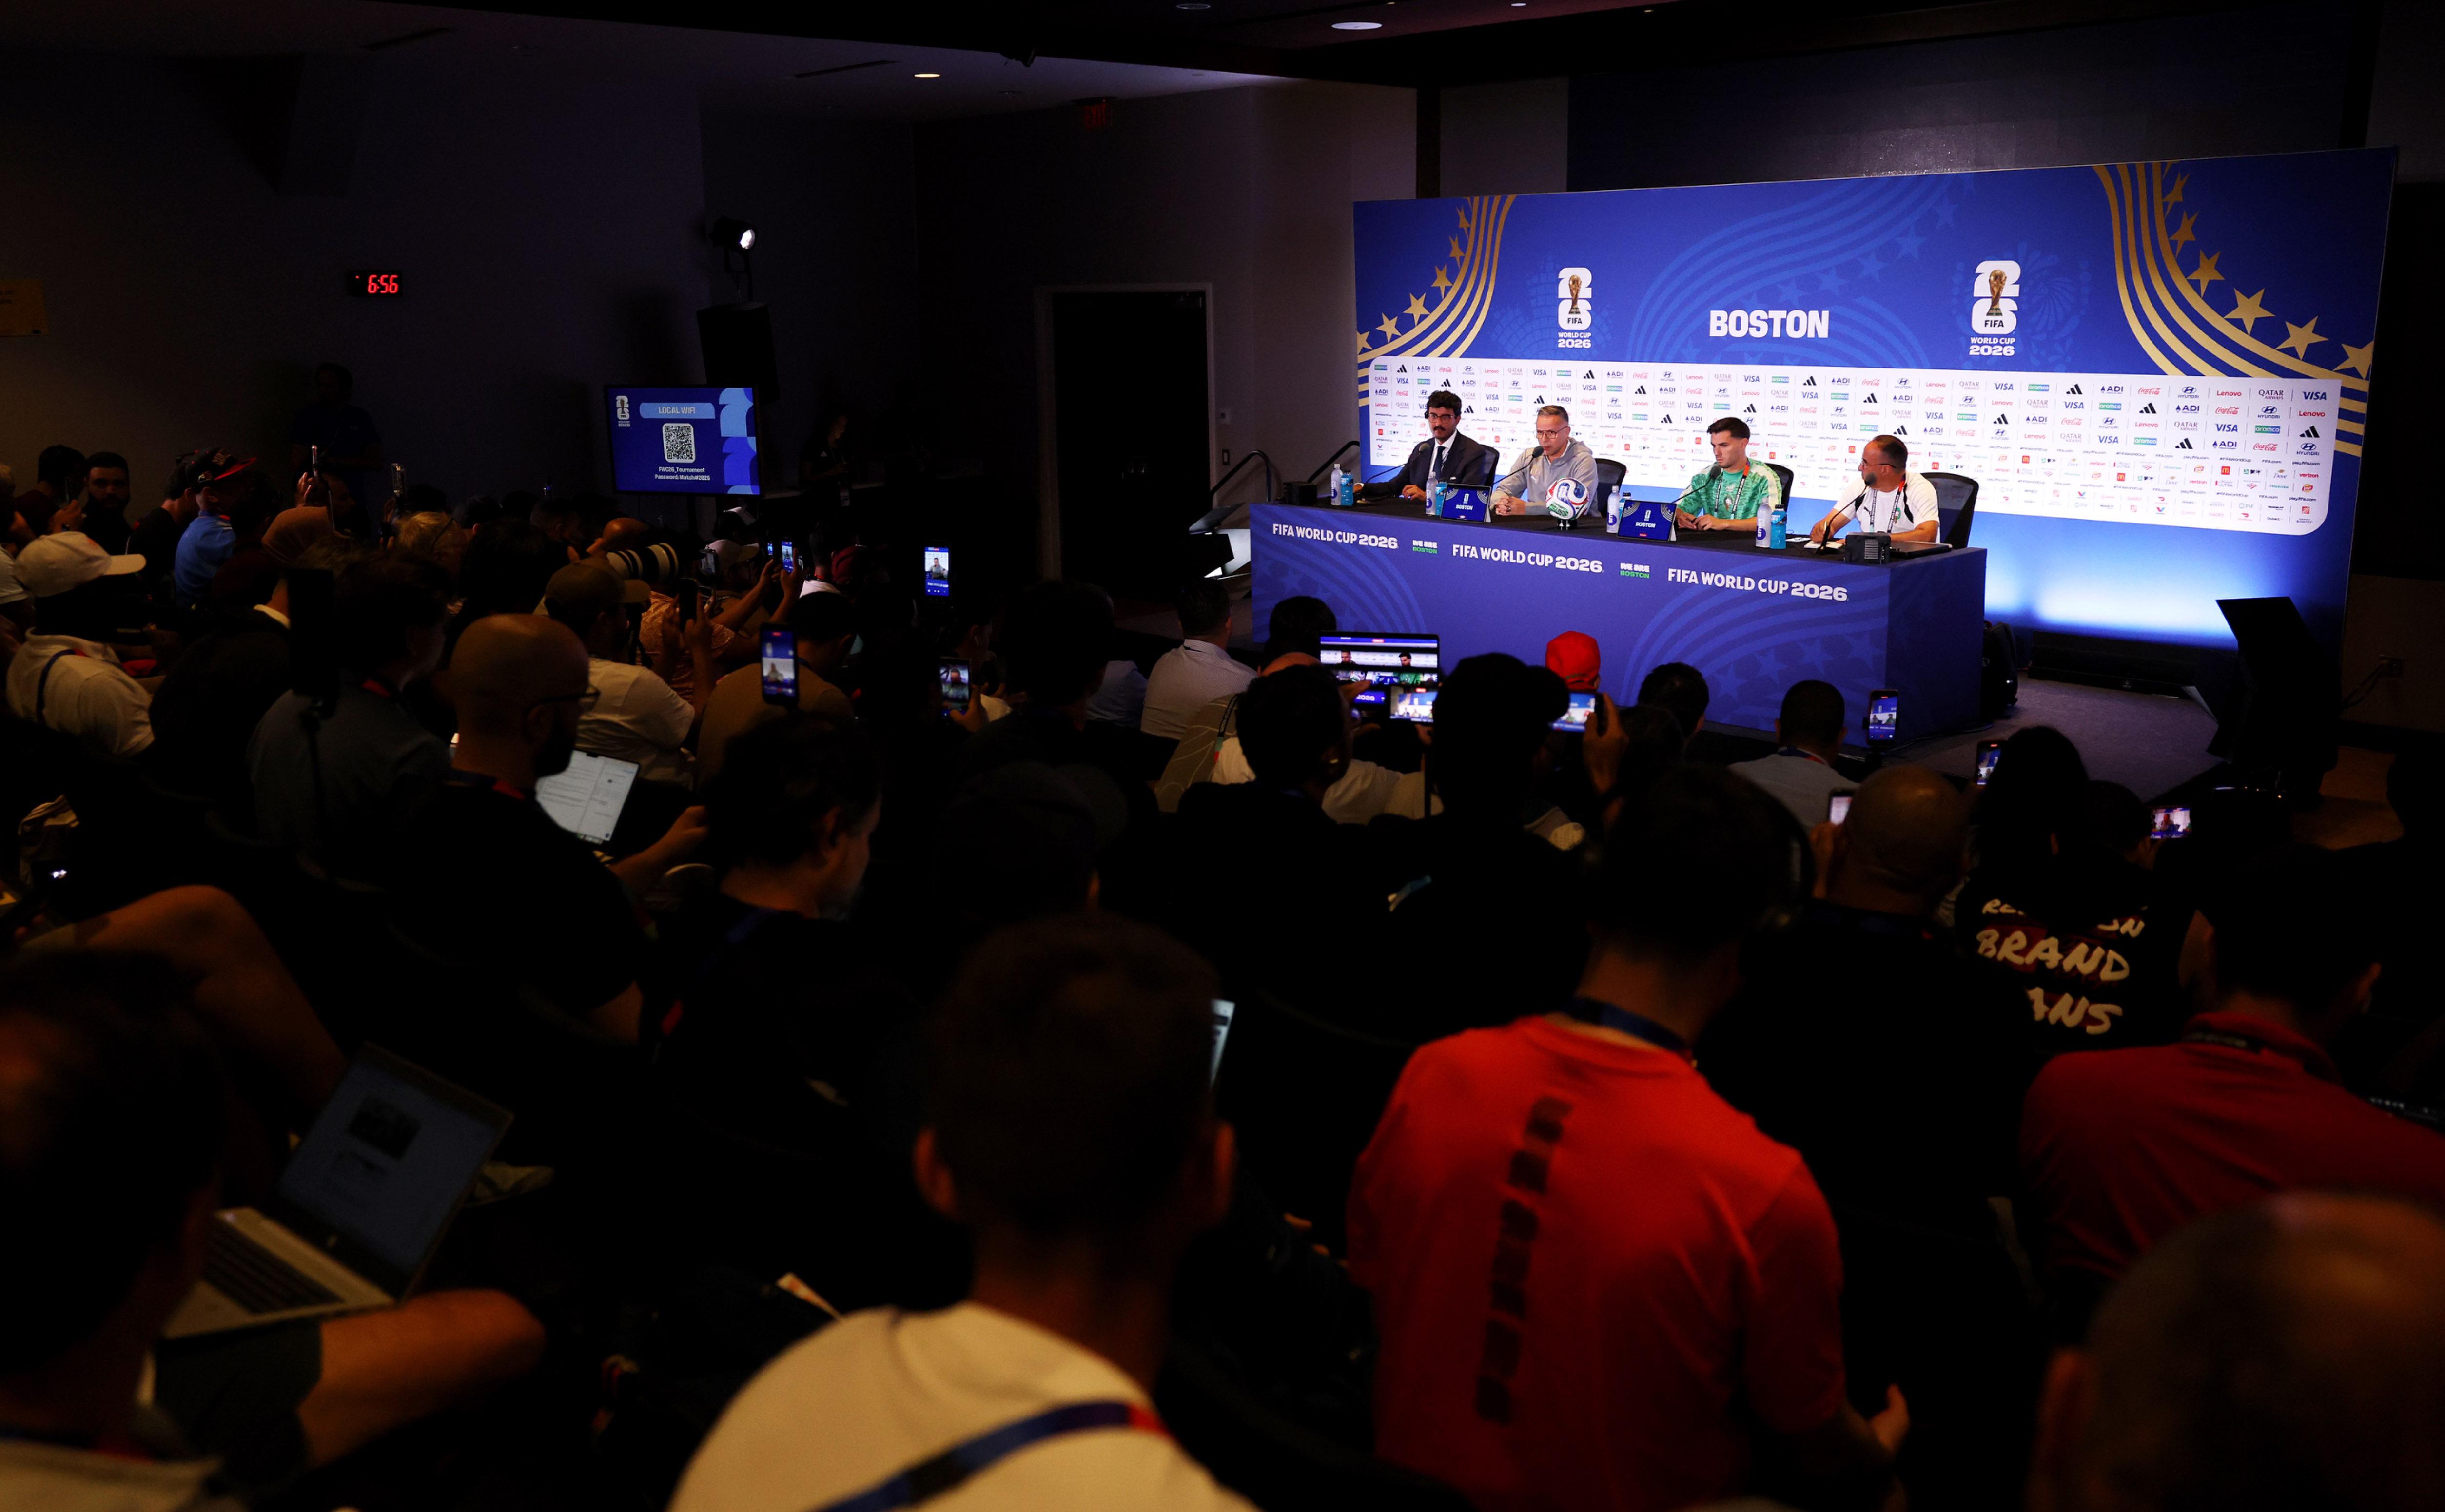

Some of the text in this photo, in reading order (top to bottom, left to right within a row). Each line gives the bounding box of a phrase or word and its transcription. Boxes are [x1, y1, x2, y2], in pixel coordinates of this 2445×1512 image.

[368, 275, 398, 293] 6:56
[1709, 310, 1829, 338] BOSTON
[1558, 339, 1591, 348] 2026
[1969, 345, 2015, 356] 2026
[2303, 392, 2327, 400] VISA
[2064, 401, 2084, 409] VISA
[2215, 423, 2238, 432] VISA
[2098, 435, 2118, 444] VISA
[1273, 524, 1398, 549] FIFA WORLD CUP 2026
[1453, 544, 1602, 572] FIFA WORLD CUP 2026
[1620, 570, 1649, 578] BOSTON
[1668, 568, 1847, 601] FIFA WORLD CUP 2026
[1976, 929, 2130, 982] BRAND
